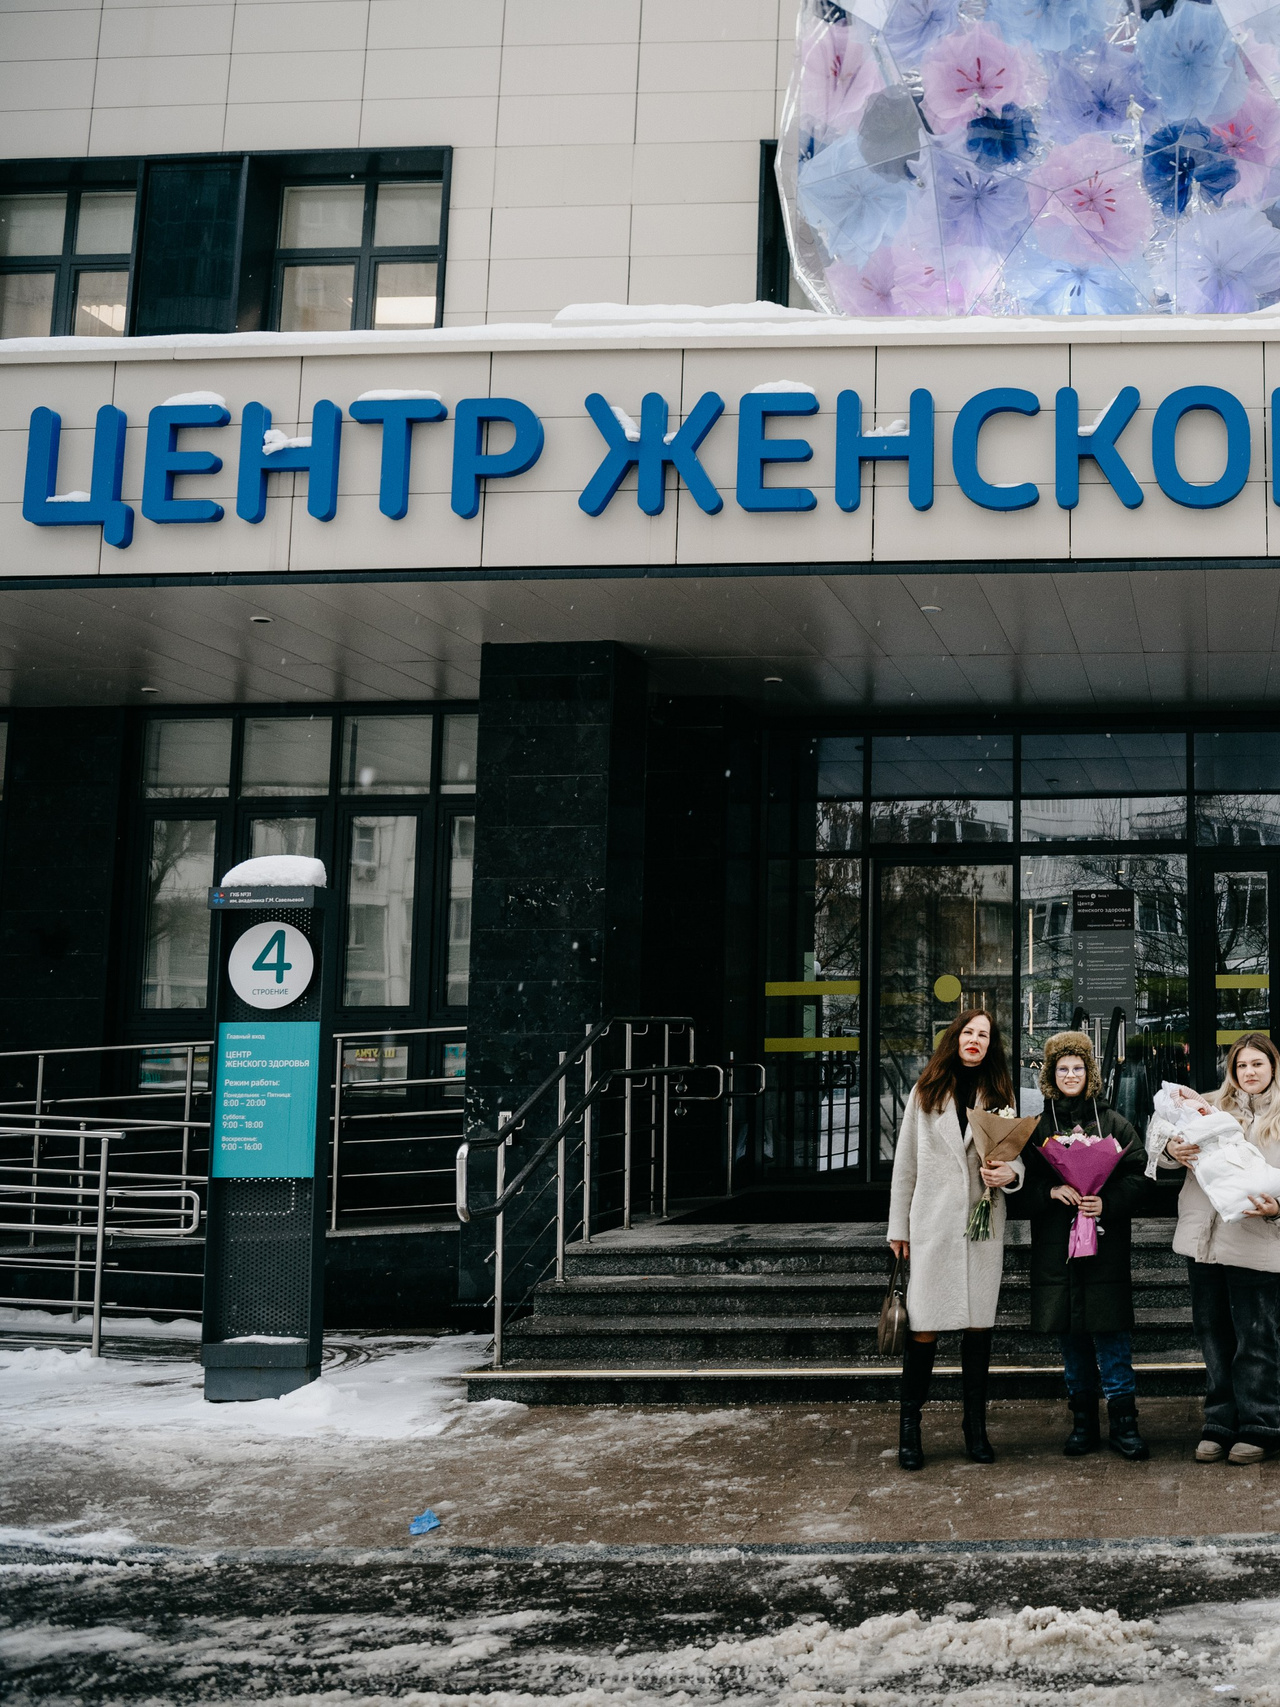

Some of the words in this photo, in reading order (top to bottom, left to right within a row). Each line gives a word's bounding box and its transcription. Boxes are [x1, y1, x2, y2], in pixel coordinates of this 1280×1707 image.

[22, 397, 545, 549] ЦЕНТР
[1077, 942, 1084, 950] 5
[252, 929, 292, 984] 4
[1077, 959, 1084, 968] 4
[1078, 977, 1084, 986] 3
[251, 988, 289, 996] СТРОЕНИЕ
[1078, 995, 1084, 1003] 2
[225, 1050, 252, 1059] ЦЕНТР
[224, 1059, 267, 1068] ЖЕНСКОГО
[268, 1059, 310, 1068] ЗДОРОВЬЯ
[224, 1079, 250, 1087] Режим
[250, 1079, 281, 1088] работы:
[223, 1099, 238, 1107] 8:00
[245, 1099, 267, 1107] 20:00
[222, 1121, 238, 1129] 9:00
[244, 1121, 264, 1129] 18:00
[221, 1143, 237, 1151] 9:00
[243, 1143, 263, 1151] 16:00
